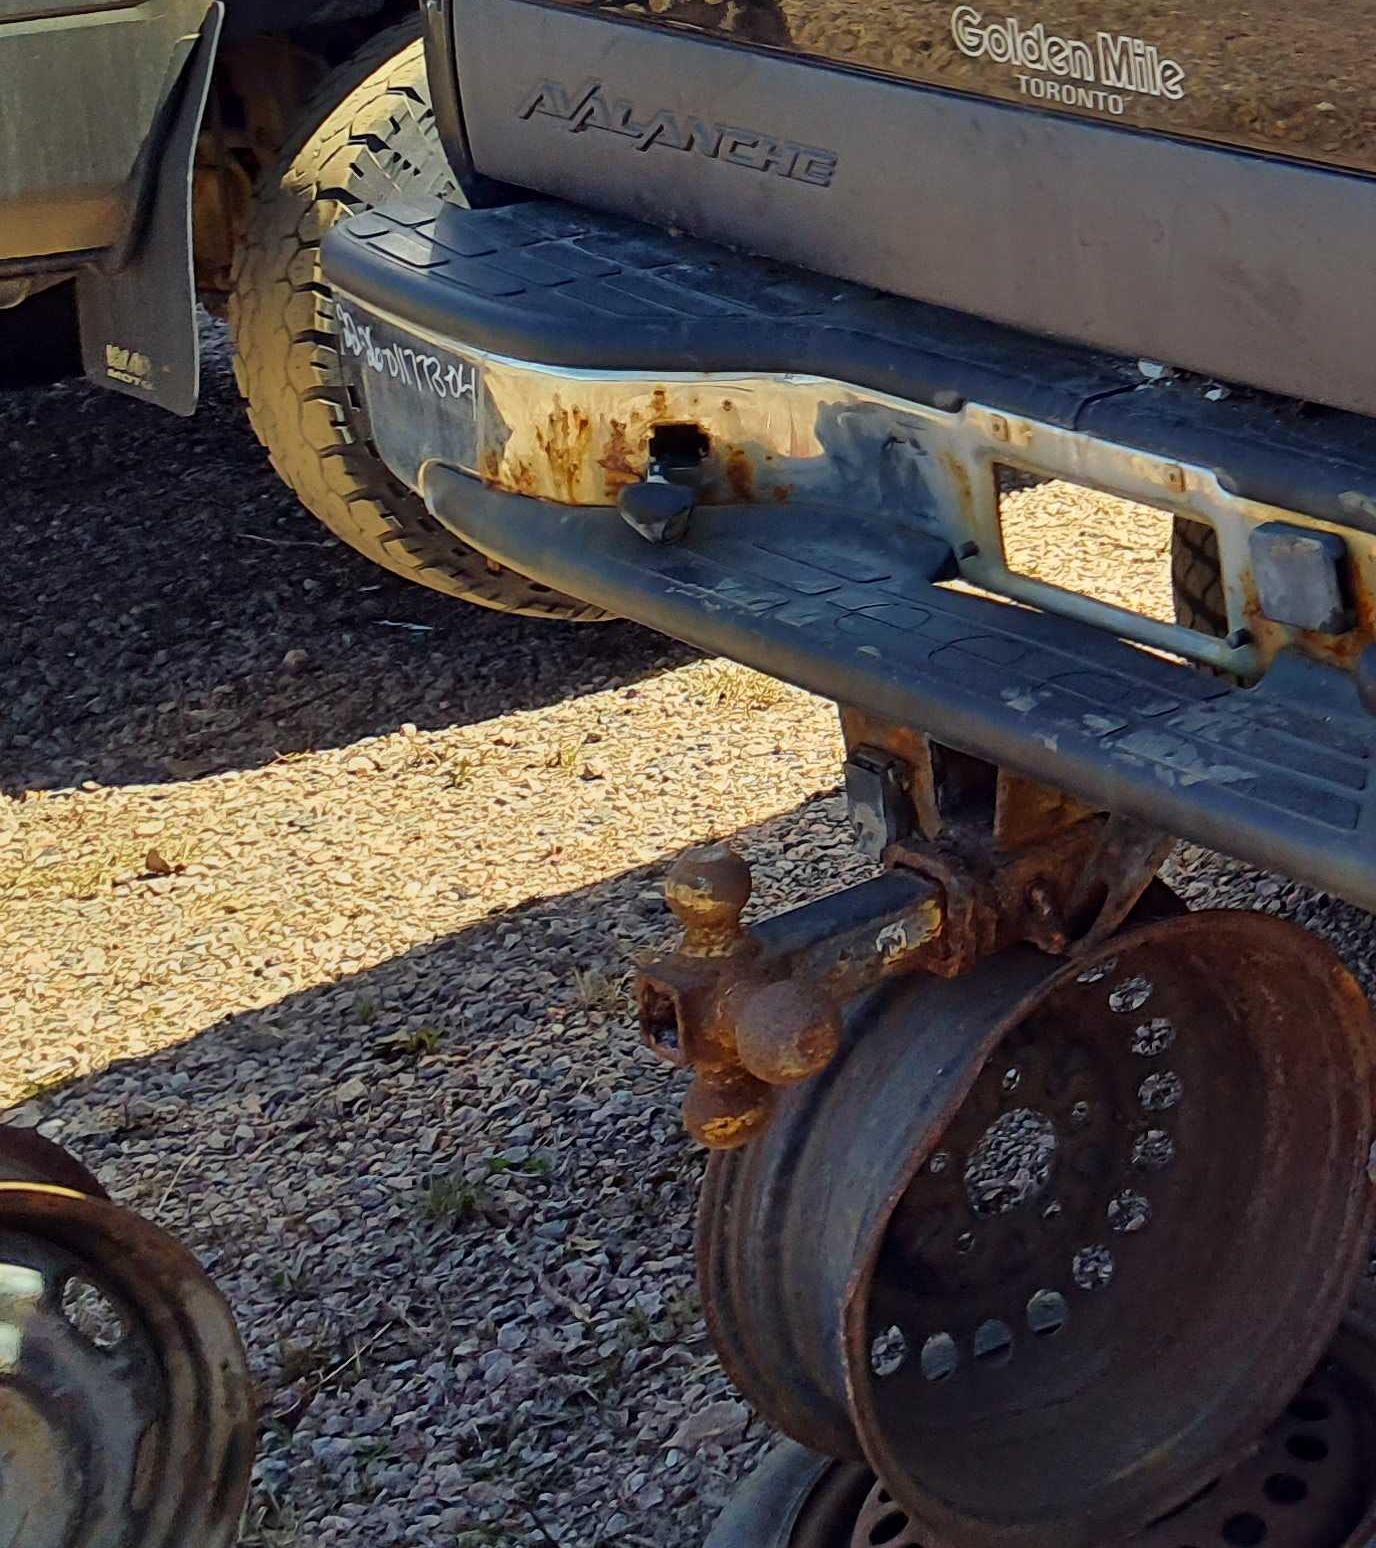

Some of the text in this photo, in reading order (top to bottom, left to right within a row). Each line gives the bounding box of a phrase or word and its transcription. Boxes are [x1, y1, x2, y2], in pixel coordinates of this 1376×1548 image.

[950, 5, 1187, 101] Golden Mile
[1016, 73, 1128, 116] TORONTO
[515, 74, 838, 188] AVALANCHE
